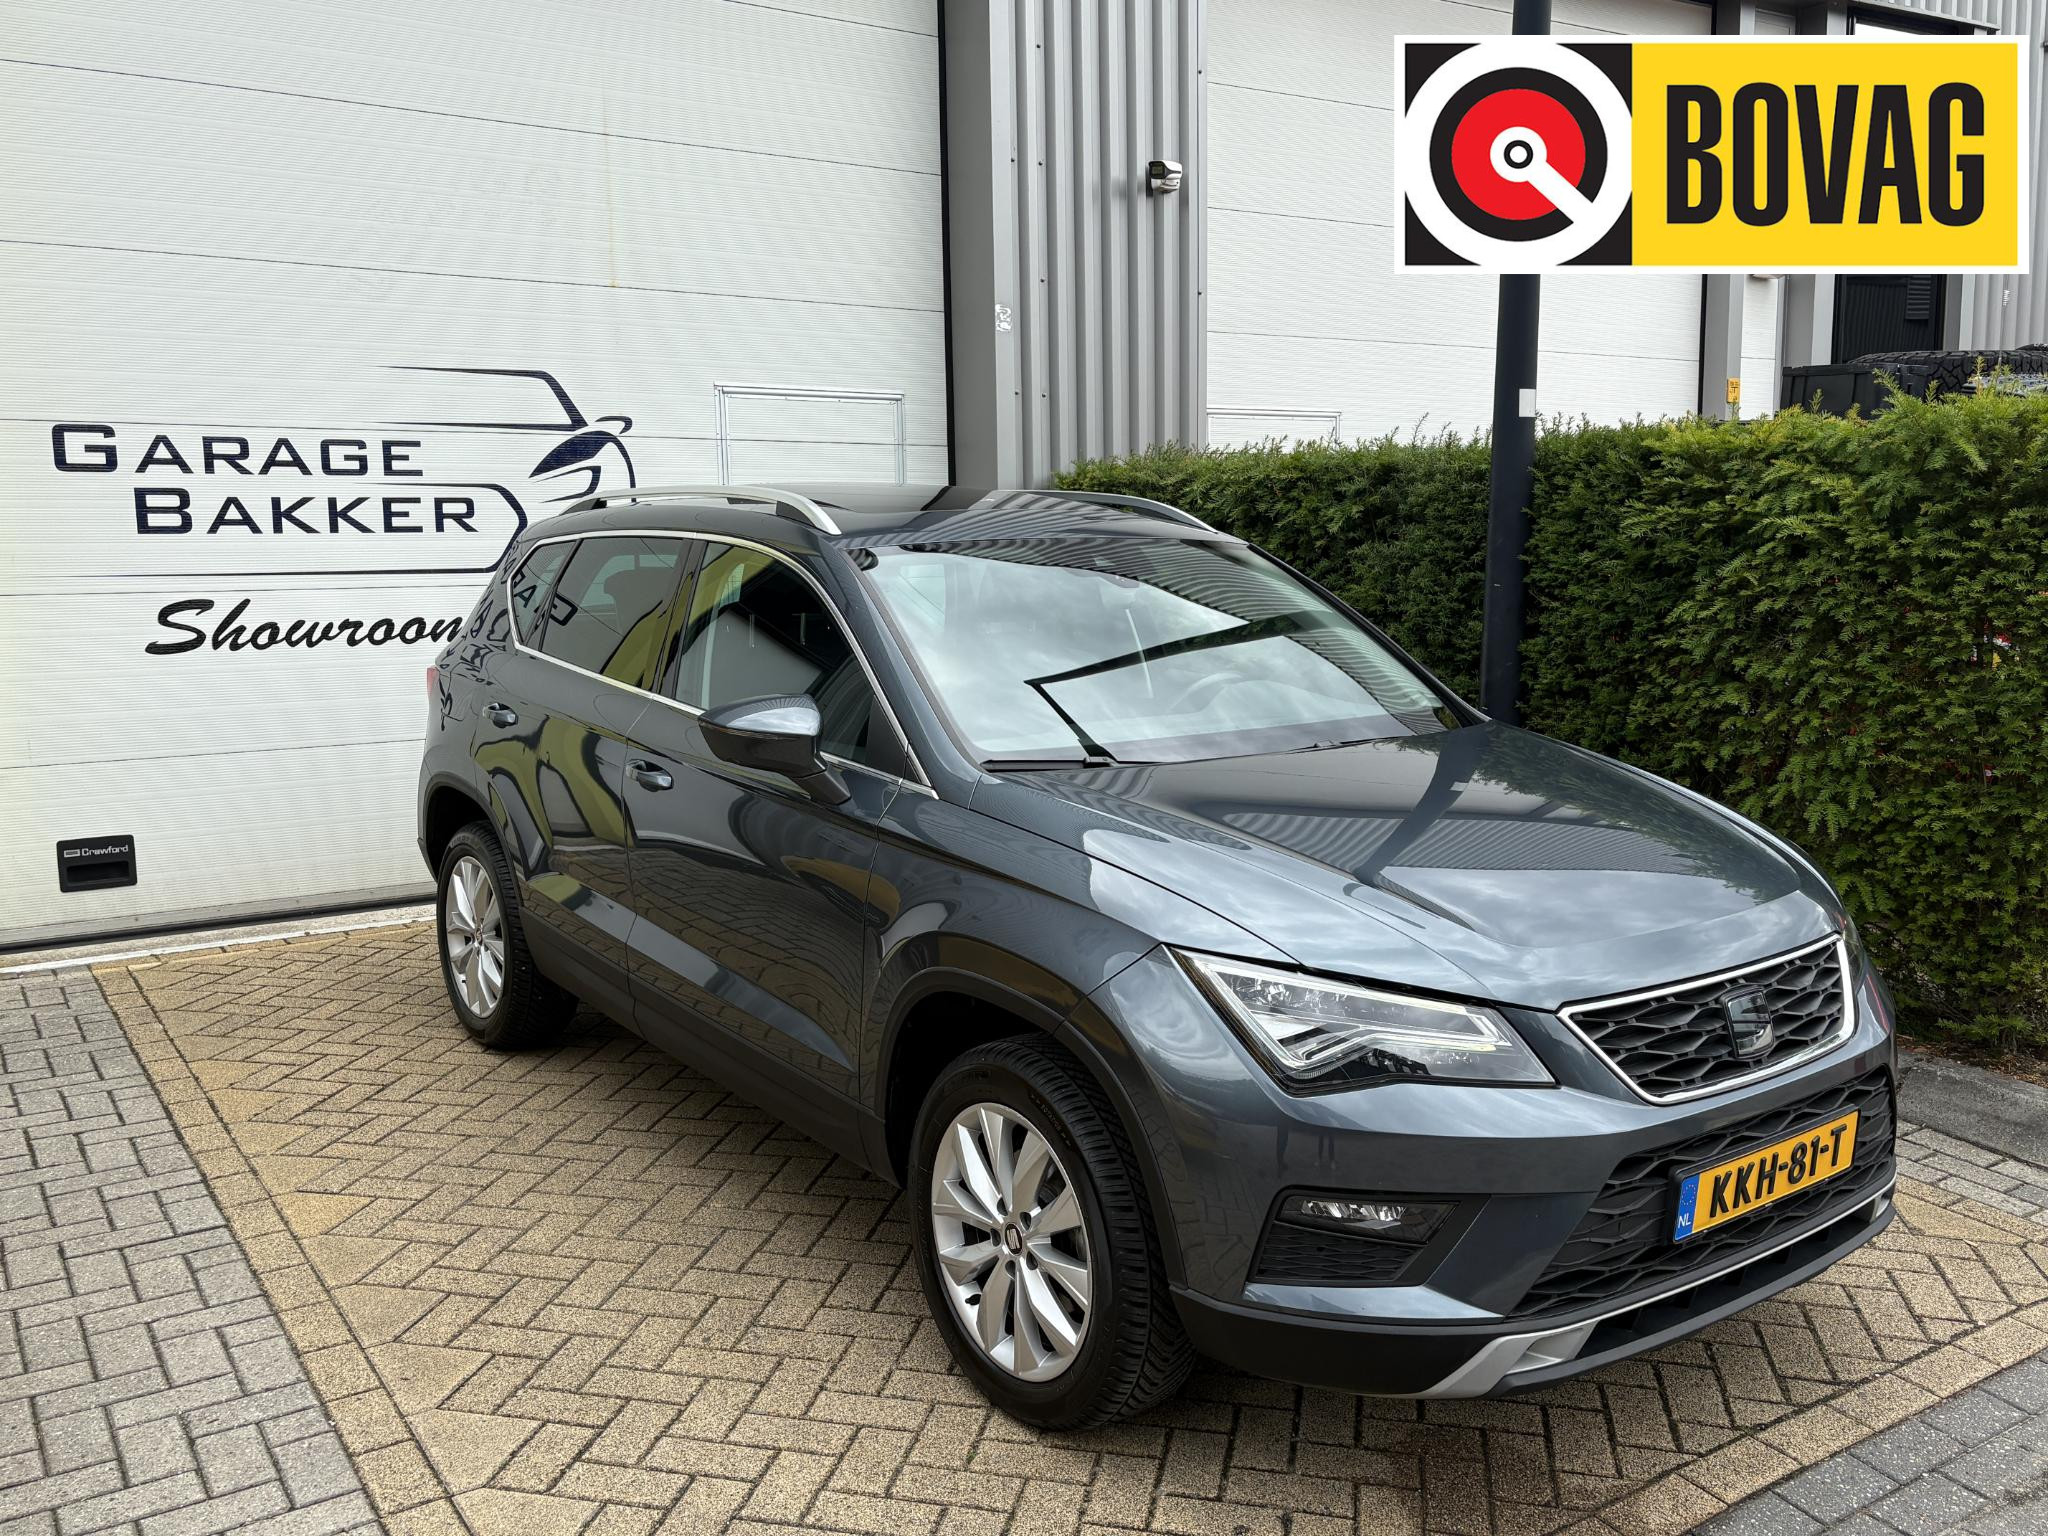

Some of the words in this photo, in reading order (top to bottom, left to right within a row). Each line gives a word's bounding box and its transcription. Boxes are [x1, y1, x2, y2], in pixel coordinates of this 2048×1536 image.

[52, 424, 424, 477] GARAGE
[134, 487, 479, 535] BAKKER
[81, 844, 129, 857] Crawford
[1709, 1123, 1847, 1218] KKH-81-T
[1678, 1213, 1692, 1229] NL
